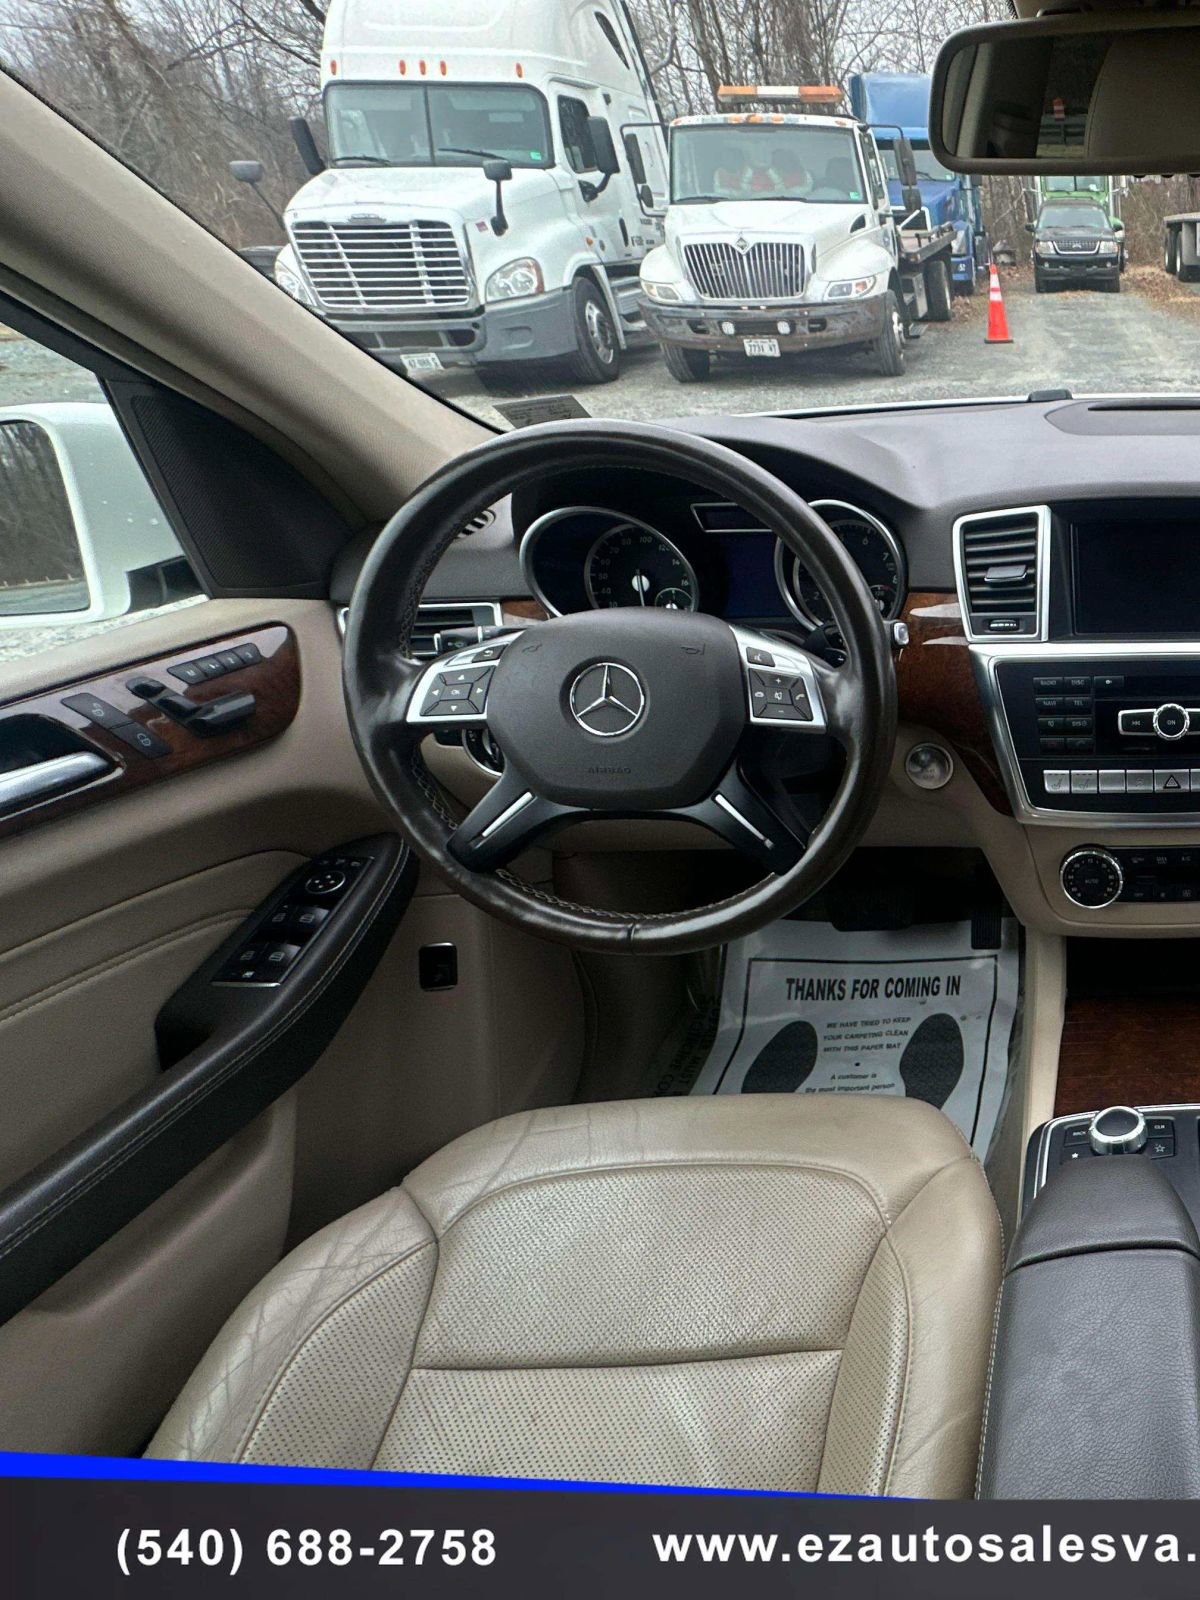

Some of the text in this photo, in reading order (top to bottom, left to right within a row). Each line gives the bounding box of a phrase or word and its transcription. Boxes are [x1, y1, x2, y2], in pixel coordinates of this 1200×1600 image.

[786, 975, 961, 1000] THANKS FOR COMING IN
[860, 1019, 880, 1027] TRIED
[844, 1031, 884, 1040] CARPETING
[885, 1042, 902, 1050] MAT
[837, 1085, 870, 1093] important
[871, 1083, 895, 1092] person
